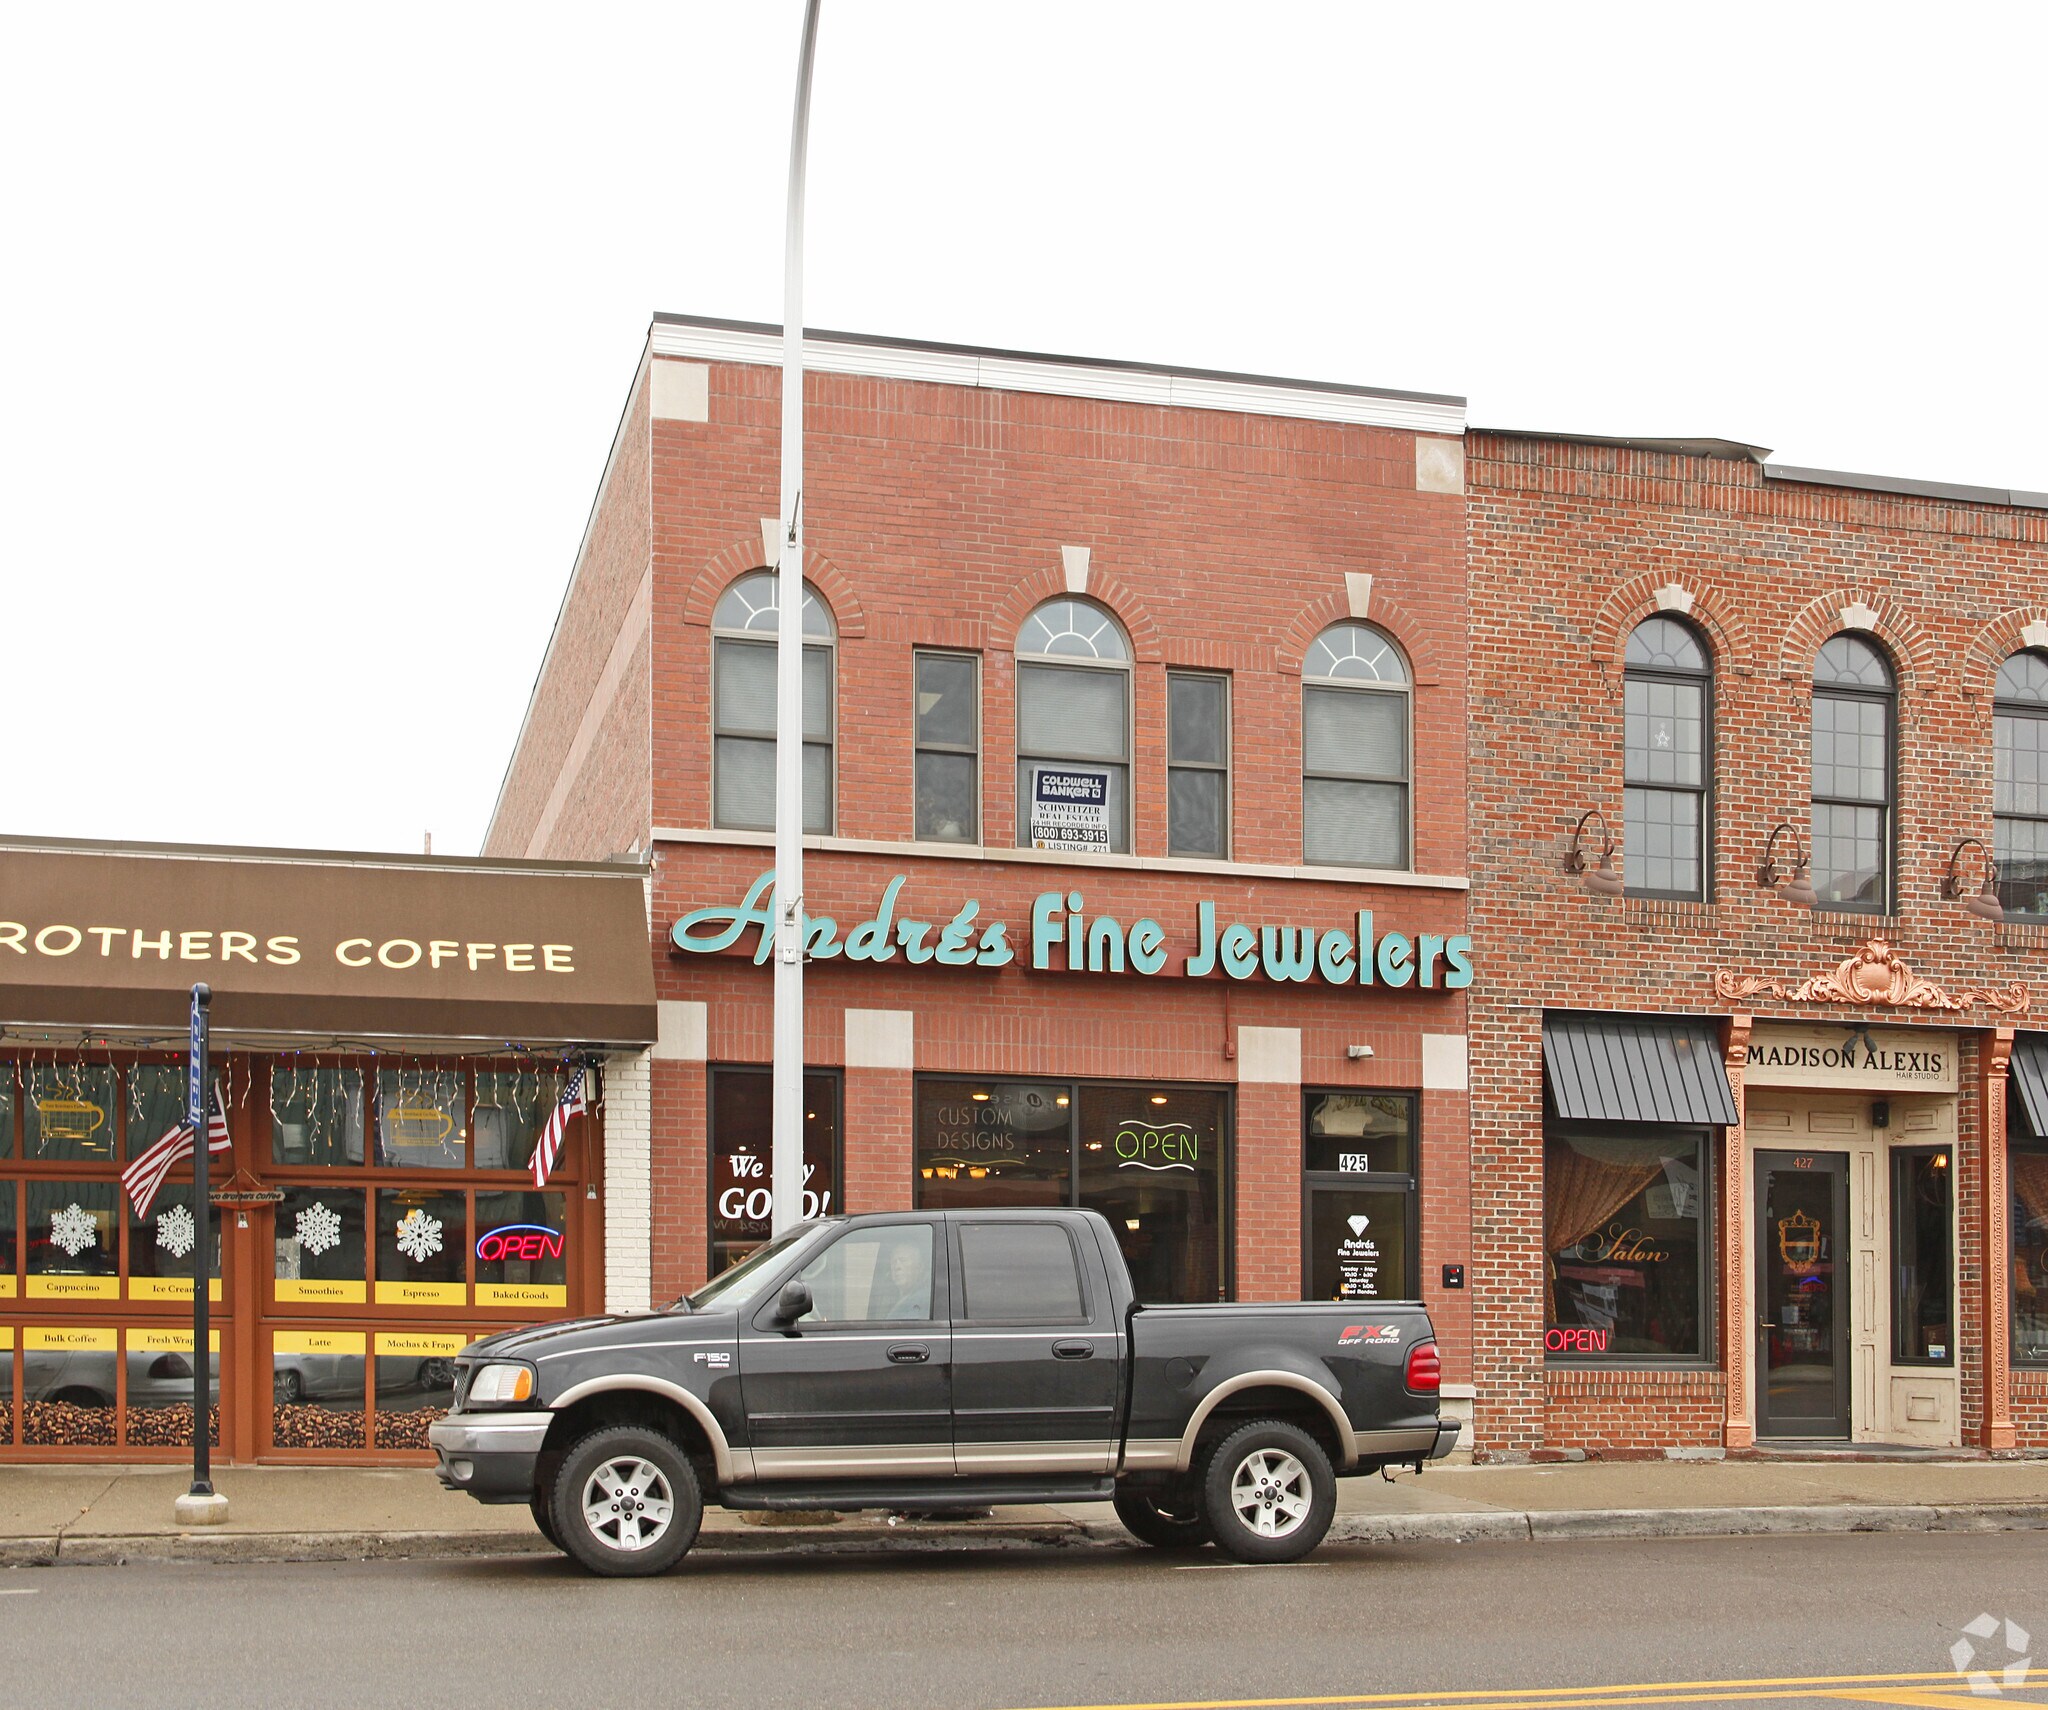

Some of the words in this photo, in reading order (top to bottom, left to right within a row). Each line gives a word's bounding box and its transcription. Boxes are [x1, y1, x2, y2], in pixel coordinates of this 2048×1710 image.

[1038, 803, 1100, 815] SCHWEITZER
[1039, 812, 1061, 820] REAL
[1066, 814, 1101, 822] ESTATE
[1052, 821, 1090, 829] RECORDED
[1034, 826, 1058, 839] (800)
[1061, 829, 1106, 842] 693-3915
[1048, 842, 1088, 852] LISTING#
[1093, 845, 1107, 853] 271
[0, 921, 301, 965] ROTHERS
[335, 938, 575, 973] COFFEE
[1186, 900, 1473, 989] Jewelers
[1746, 1045, 1855, 1068] MADISON
[1862, 1050, 1942, 1073] ALEXIS
[1914, 1072, 1939, 1080] STUDIO
[938, 1107, 1013, 1126] CUSTOM
[938, 1131, 1014, 1151] DESIGNS
[1115, 1131, 1198, 1161] OPEN
[729, 1154, 764, 1178] We
[1340, 1155, 1366, 1171] 425
[1793, 1157, 1814, 1168] 427
[719, 1187, 831, 1221] GOD!
[480, 1234, 565, 1261] OPEN
[1344, 1239, 1375, 1249] Andrés
[1576, 1222, 1669, 1263] Salon
[1352, 1249, 1379, 1257] Jewelers
[46, 1282, 100, 1292] Cappuccino
[152, 1284, 166, 1293] Ice
[298, 1286, 344, 1296] Smoothies
[402, 1288, 440, 1299] Espresso
[493, 1290, 519, 1299] Baked
[521, 1290, 549, 1300] Goods
[1340, 1325, 1400, 1338] FX4
[44, 1334, 65, 1343] Bulk
[67, 1334, 97, 1343] Coffee
[147, 1335, 171, 1344] Fresh
[172, 1336, 195, 1347] Wrap
[308, 1338, 332, 1347] Latte
[387, 1339, 420, 1348] Mochas
[422, 1340, 430, 1348] &
[431, 1340, 455, 1350] Fraps
[1545, 1329, 1607, 1351] OPEN
